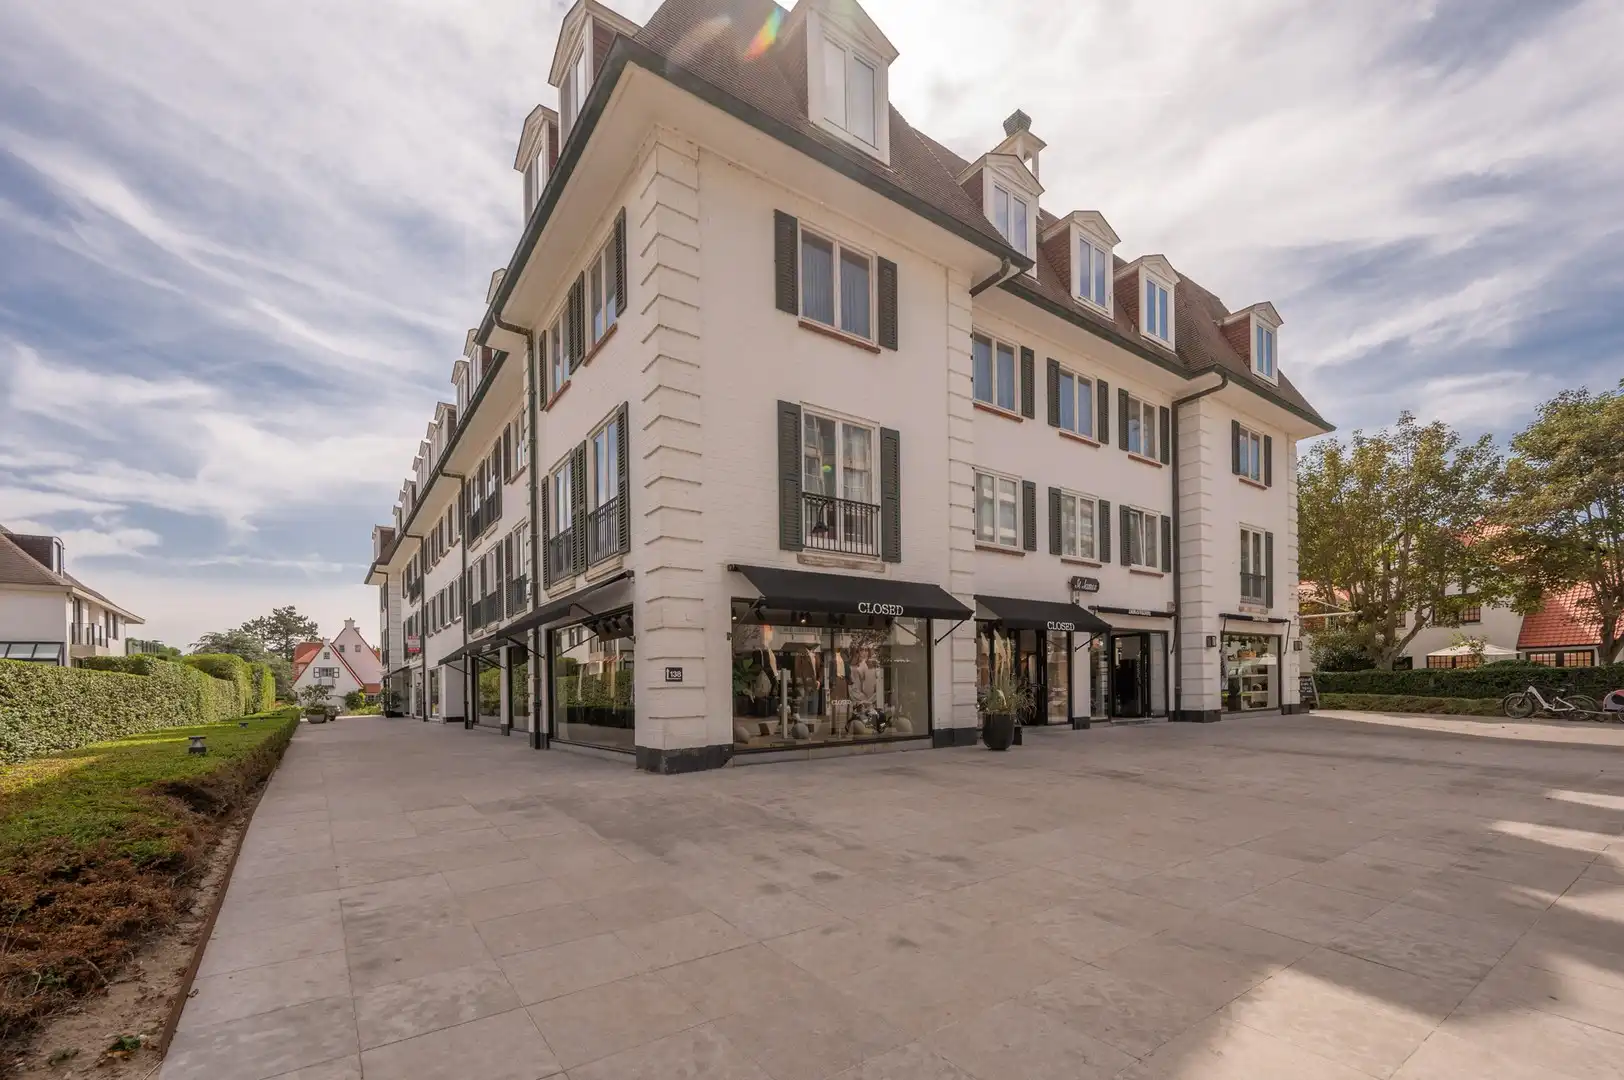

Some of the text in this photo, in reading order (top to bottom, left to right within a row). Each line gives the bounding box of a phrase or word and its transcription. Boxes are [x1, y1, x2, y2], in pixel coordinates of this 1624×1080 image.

[858, 602, 904, 616] CLOSED
[1047, 621, 1075, 631] CLOSED
[670, 670, 682, 678] 138
